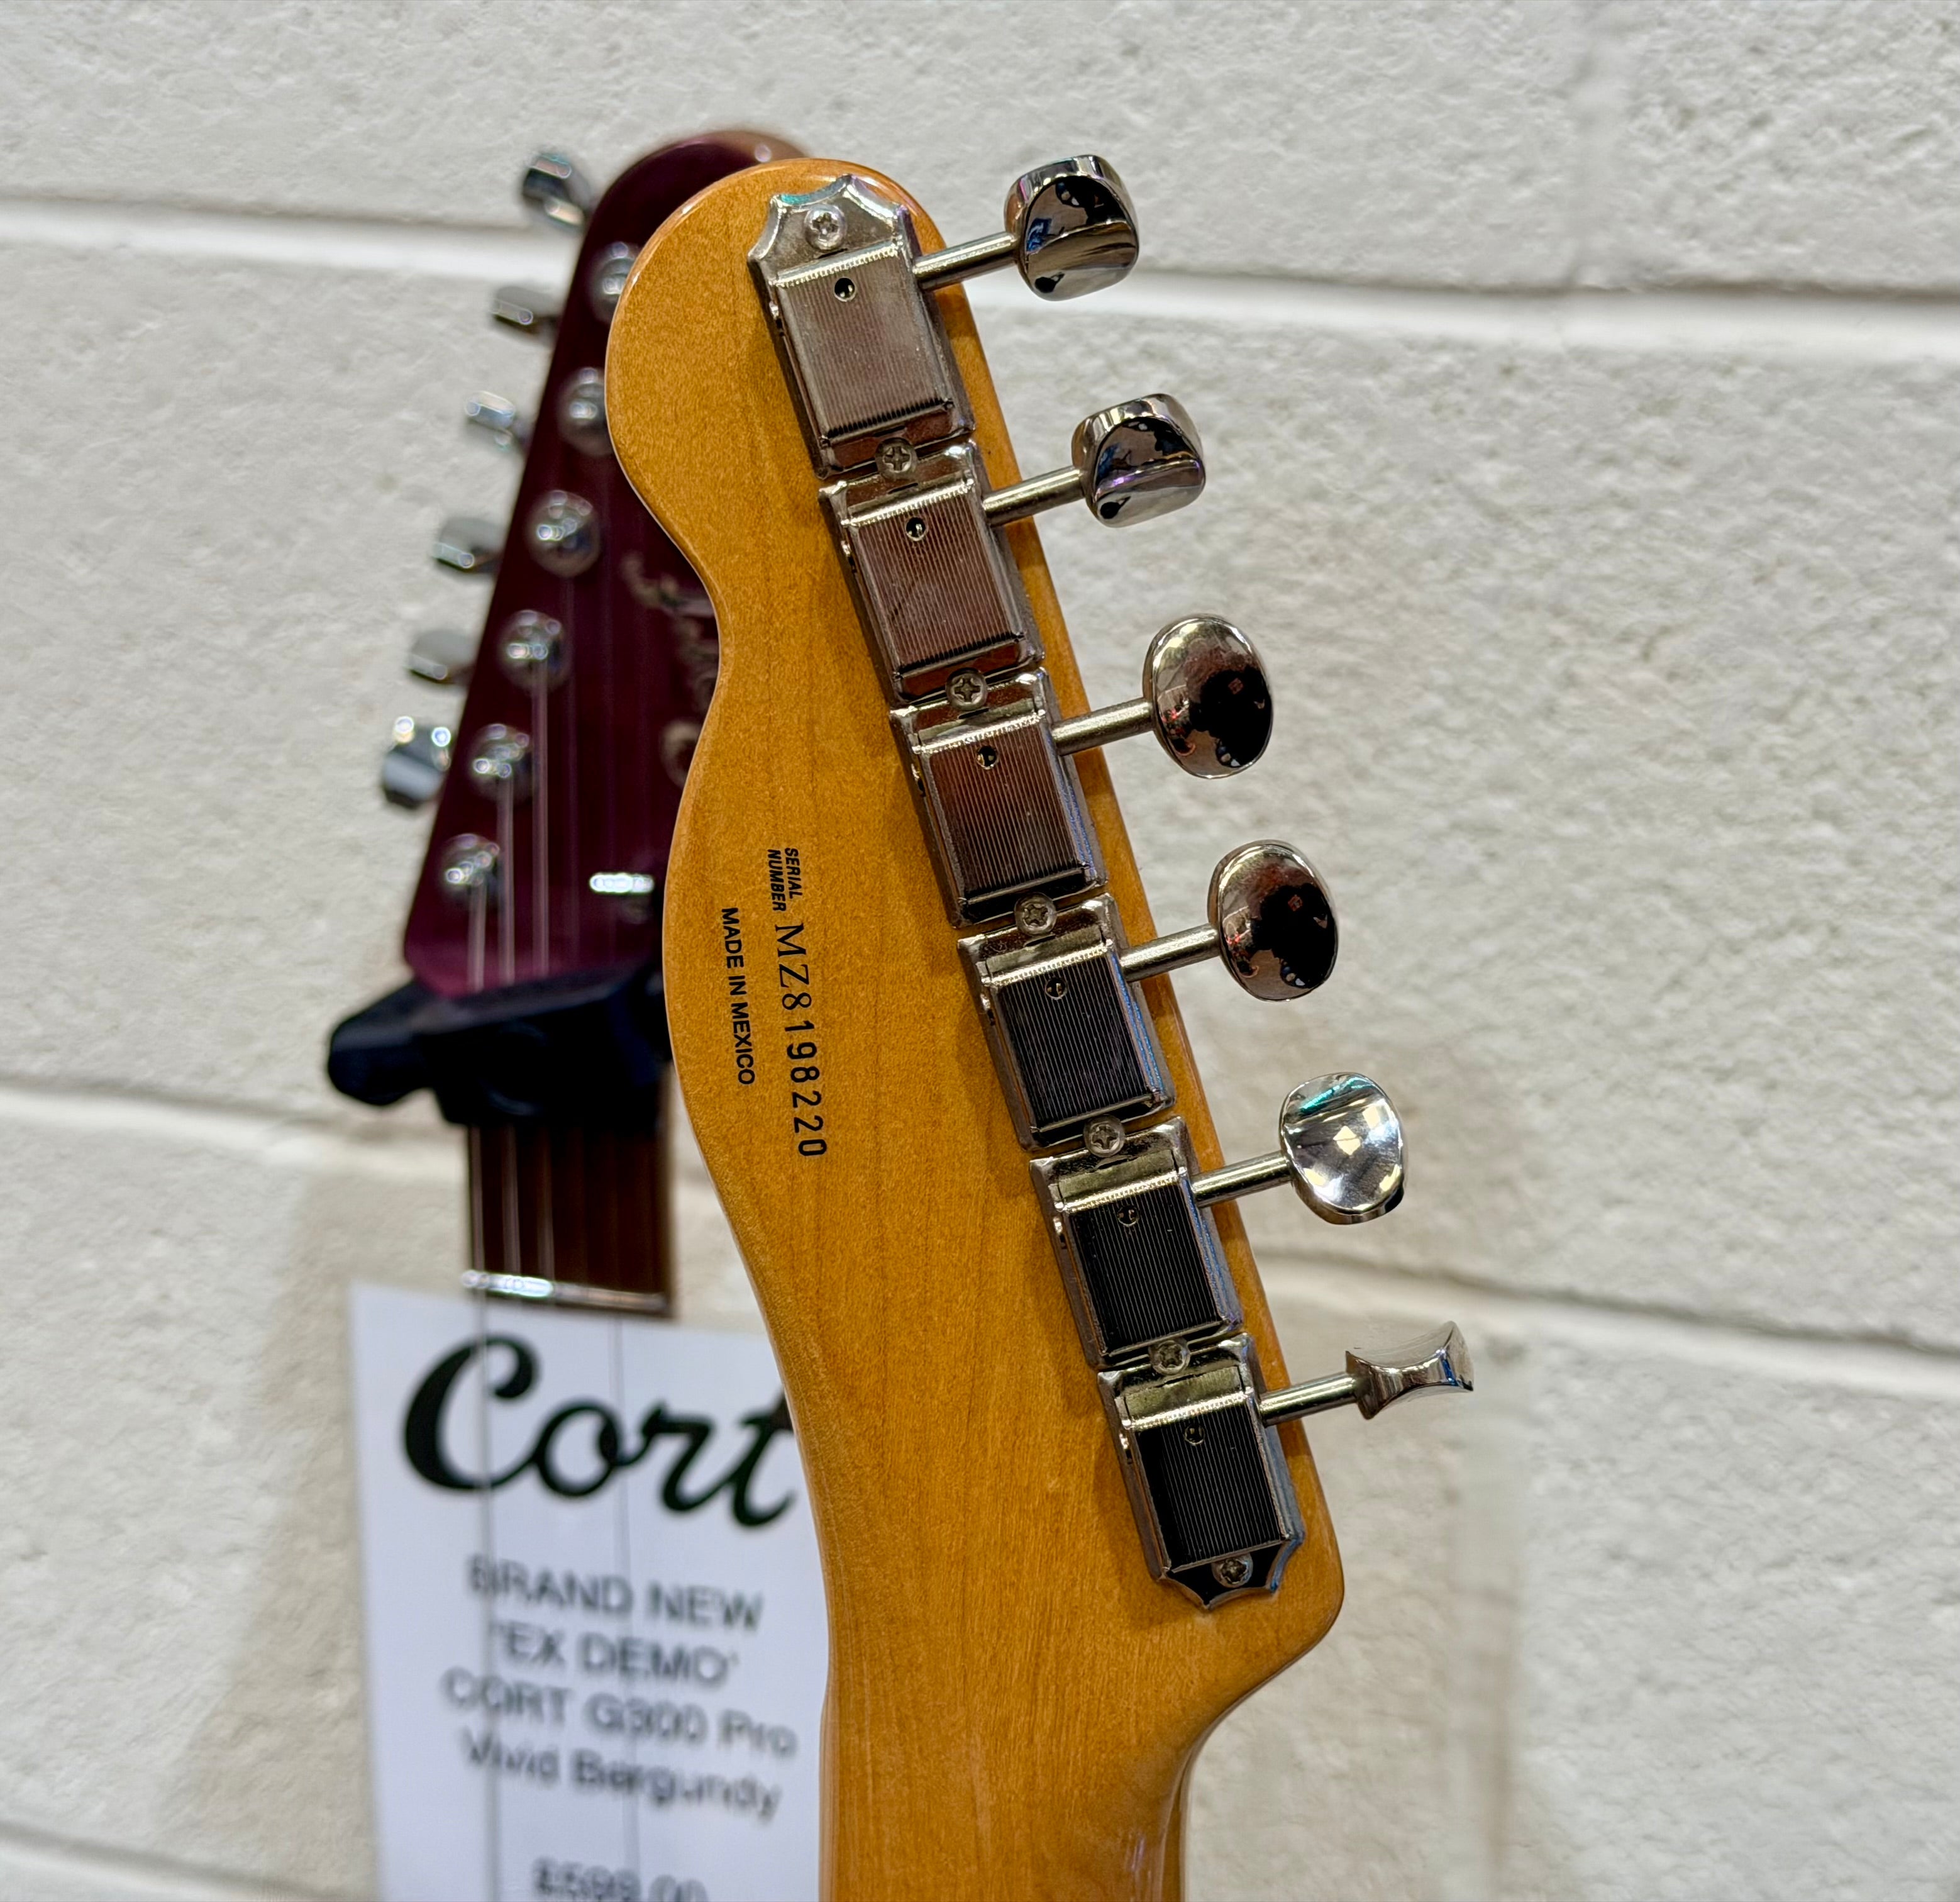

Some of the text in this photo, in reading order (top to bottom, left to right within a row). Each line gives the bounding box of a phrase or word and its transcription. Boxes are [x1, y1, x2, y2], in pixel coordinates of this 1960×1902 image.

[767, 848, 787, 912] NUMBER
[784, 847, 803, 899] SERIAL
[721, 907, 755, 1086] MADE IN MEXICO
[775, 922, 828, 1157] MZ8198220
[402, 1332, 795, 1528] Cort
[467, 1555, 763, 1631] BRAND NEW
[442, 1667, 571, 1724] CORT
[717, 1709, 797, 1759] Pro
[460, 1727, 559, 1788] Vivid
